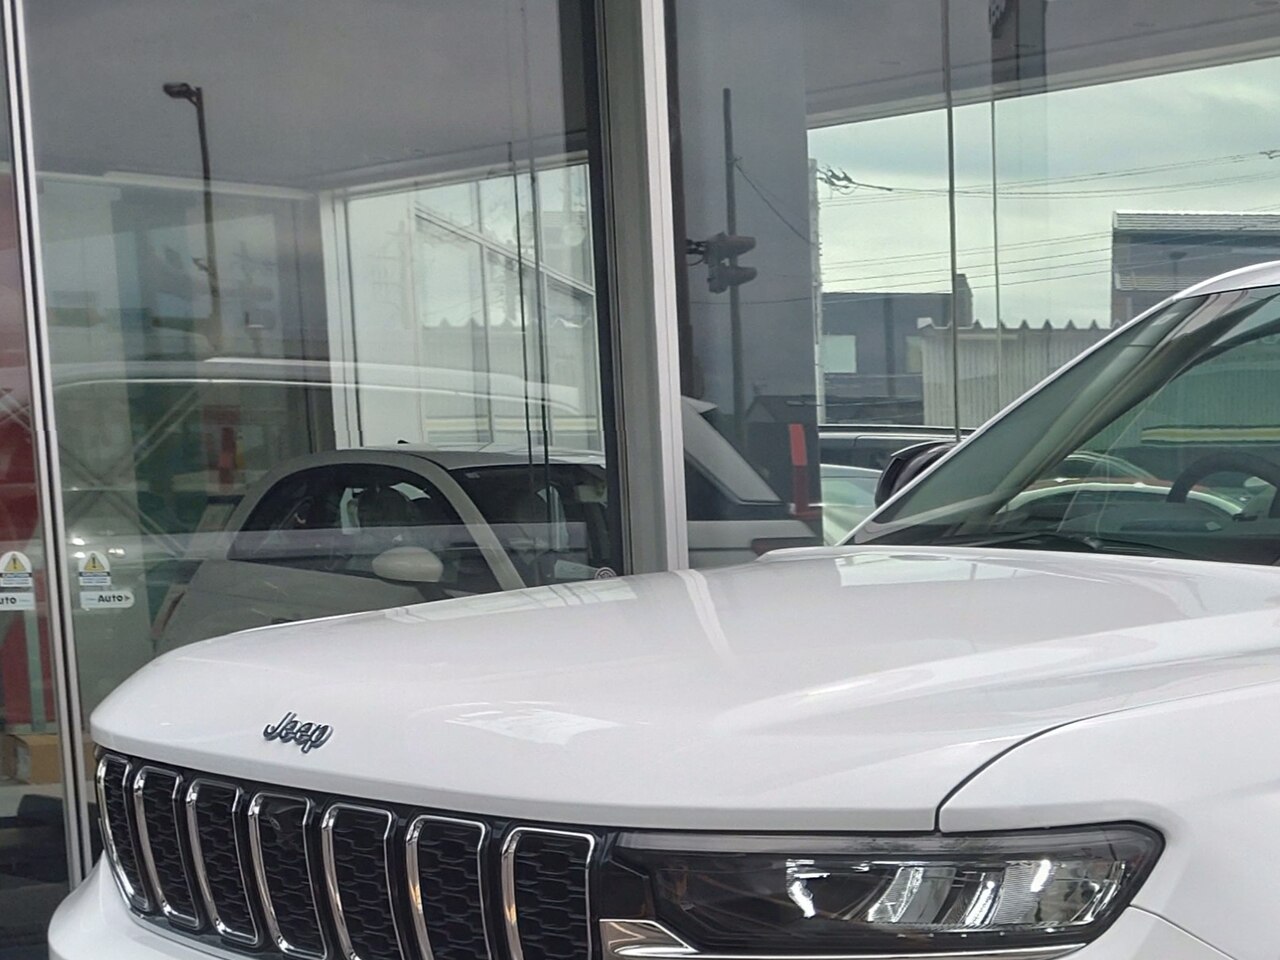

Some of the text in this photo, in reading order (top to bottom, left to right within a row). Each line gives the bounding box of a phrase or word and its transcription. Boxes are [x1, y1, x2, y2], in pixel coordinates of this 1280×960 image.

[0, 596, 17, 604] uto
[97, 594, 124, 603] Auto
[263, 711, 334, 754] Jeep
